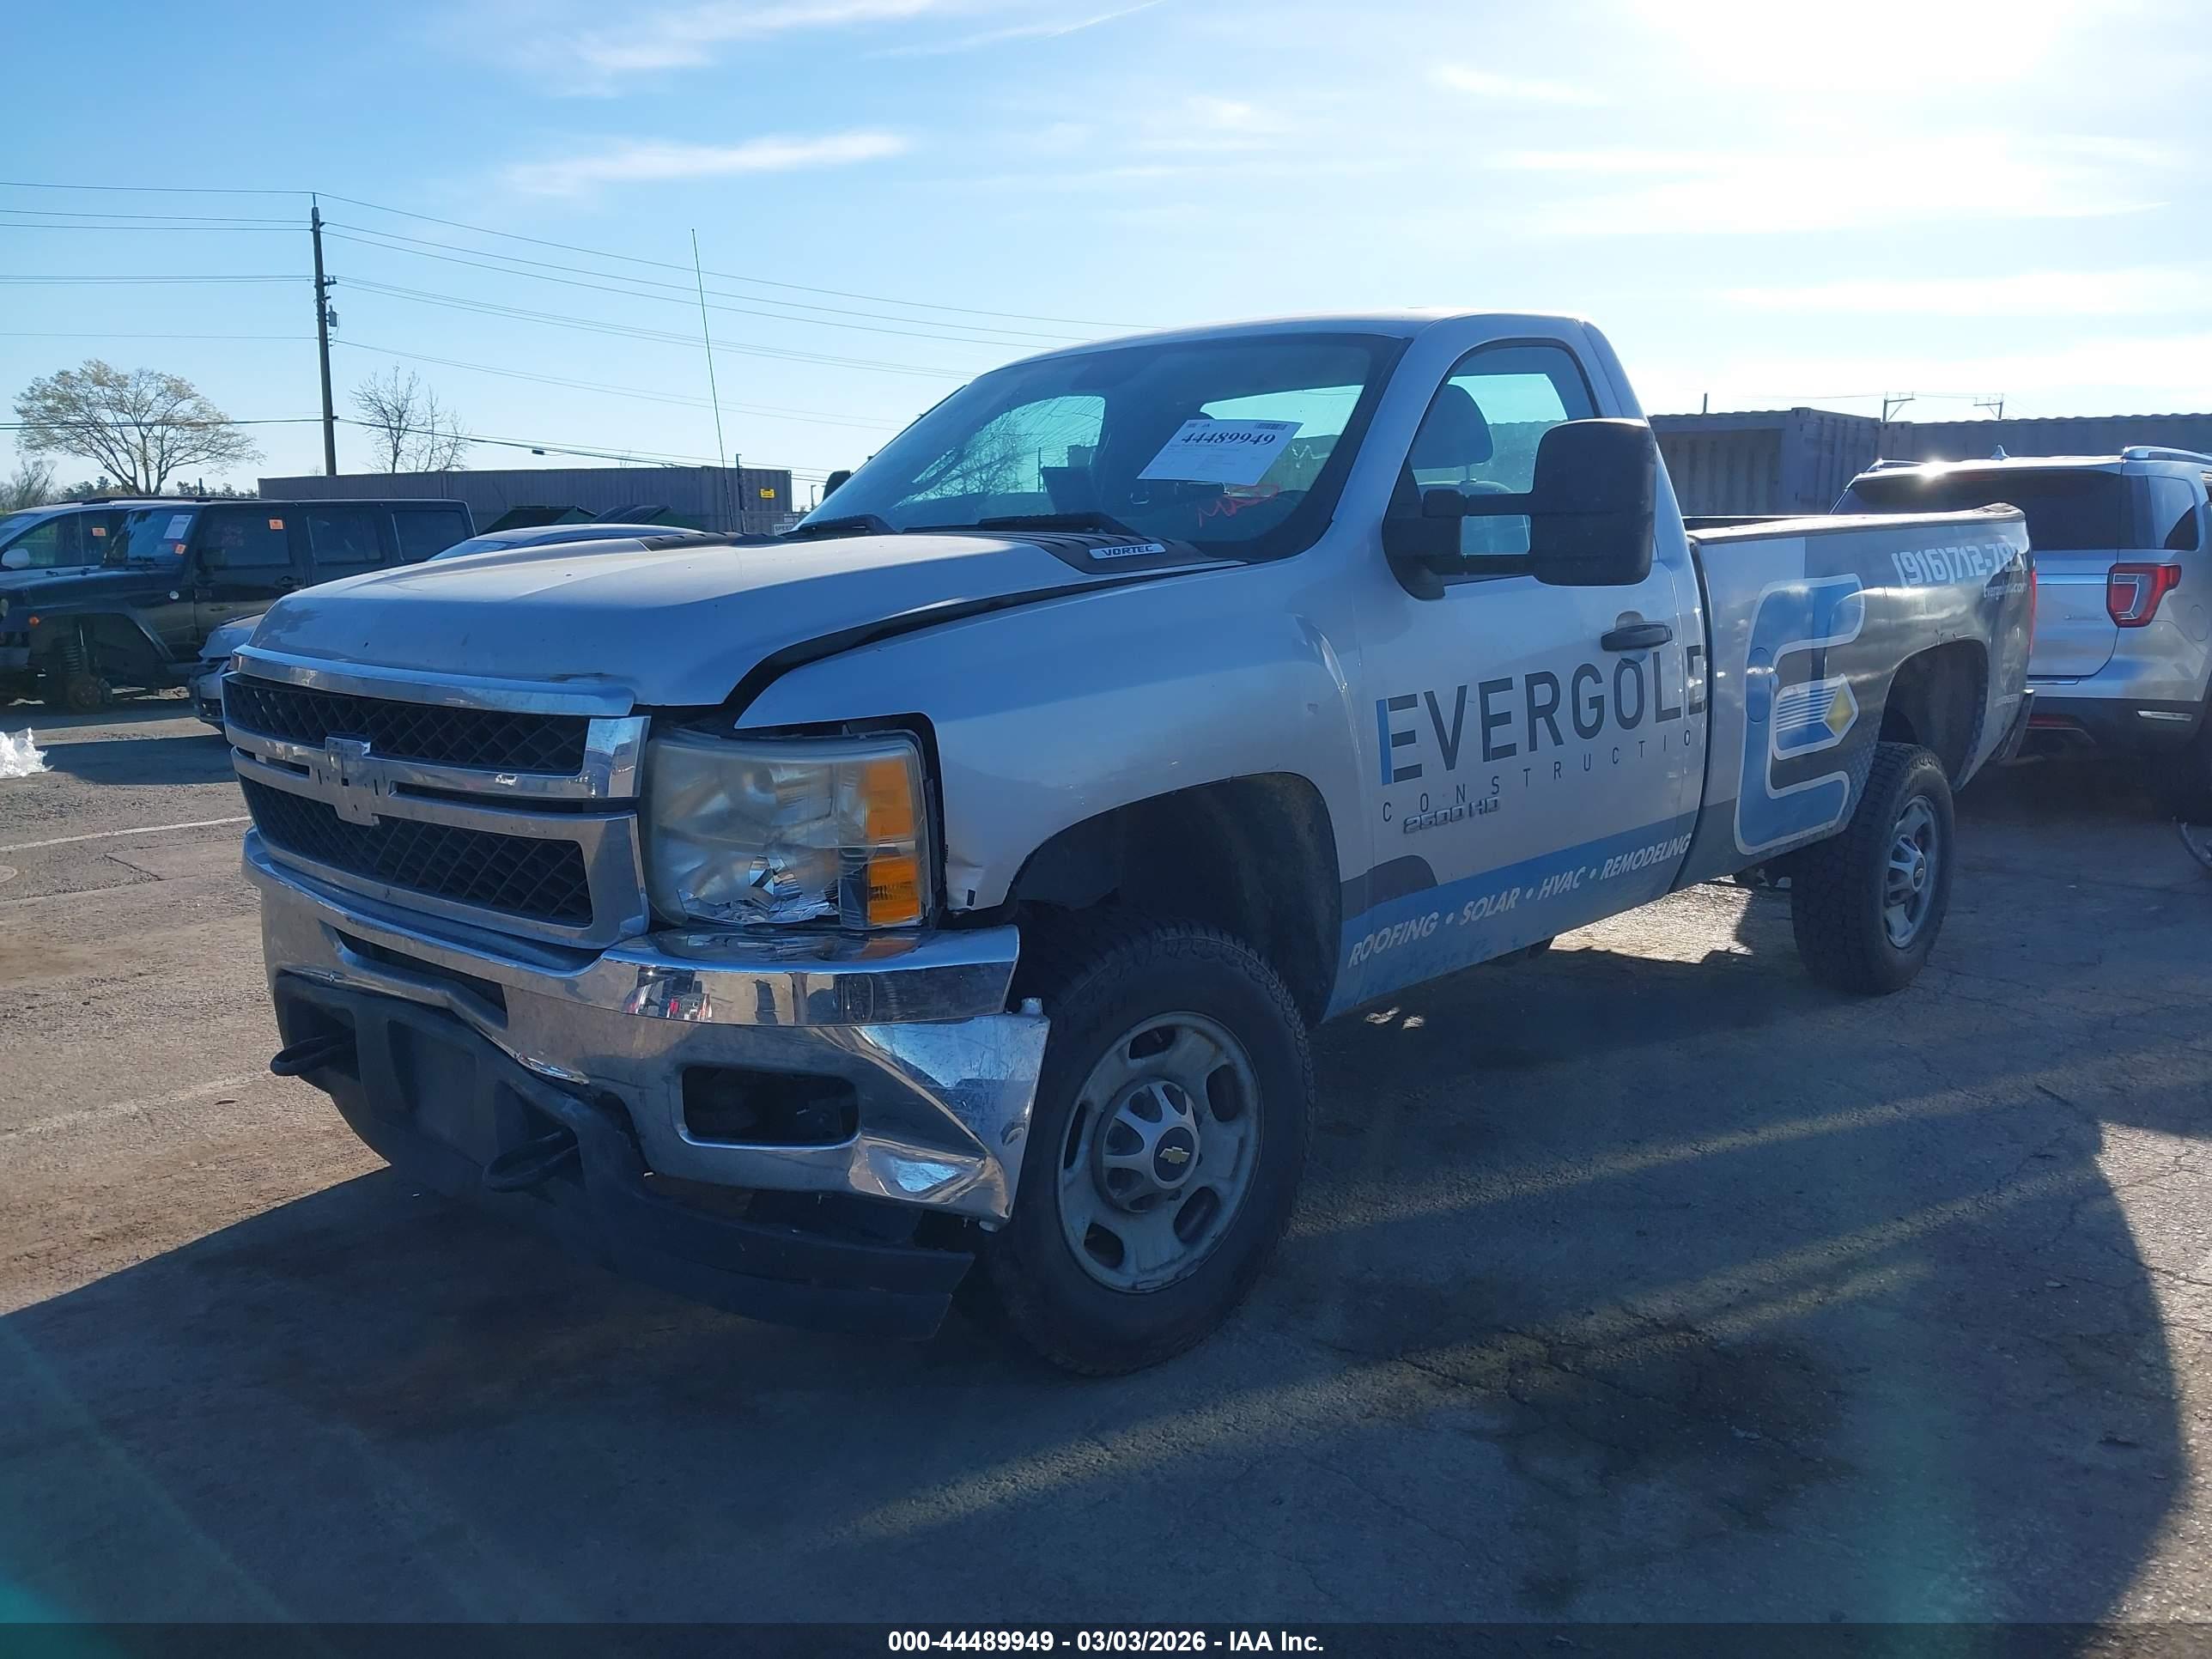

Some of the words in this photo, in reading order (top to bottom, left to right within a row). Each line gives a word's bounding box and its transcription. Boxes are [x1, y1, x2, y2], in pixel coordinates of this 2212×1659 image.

[1181, 432, 1276, 446] 44489949
[1101, 544, 1155, 556] VORTEC
[1403, 805, 1465, 835] 2500
[1469, 795, 1501, 818] HD
[1347, 912, 1440, 969] ROOFING
[1459, 886, 1521, 926] SOLAR
[1536, 866, 1587, 901] HVAC
[1599, 832, 1692, 880] REMODELING
